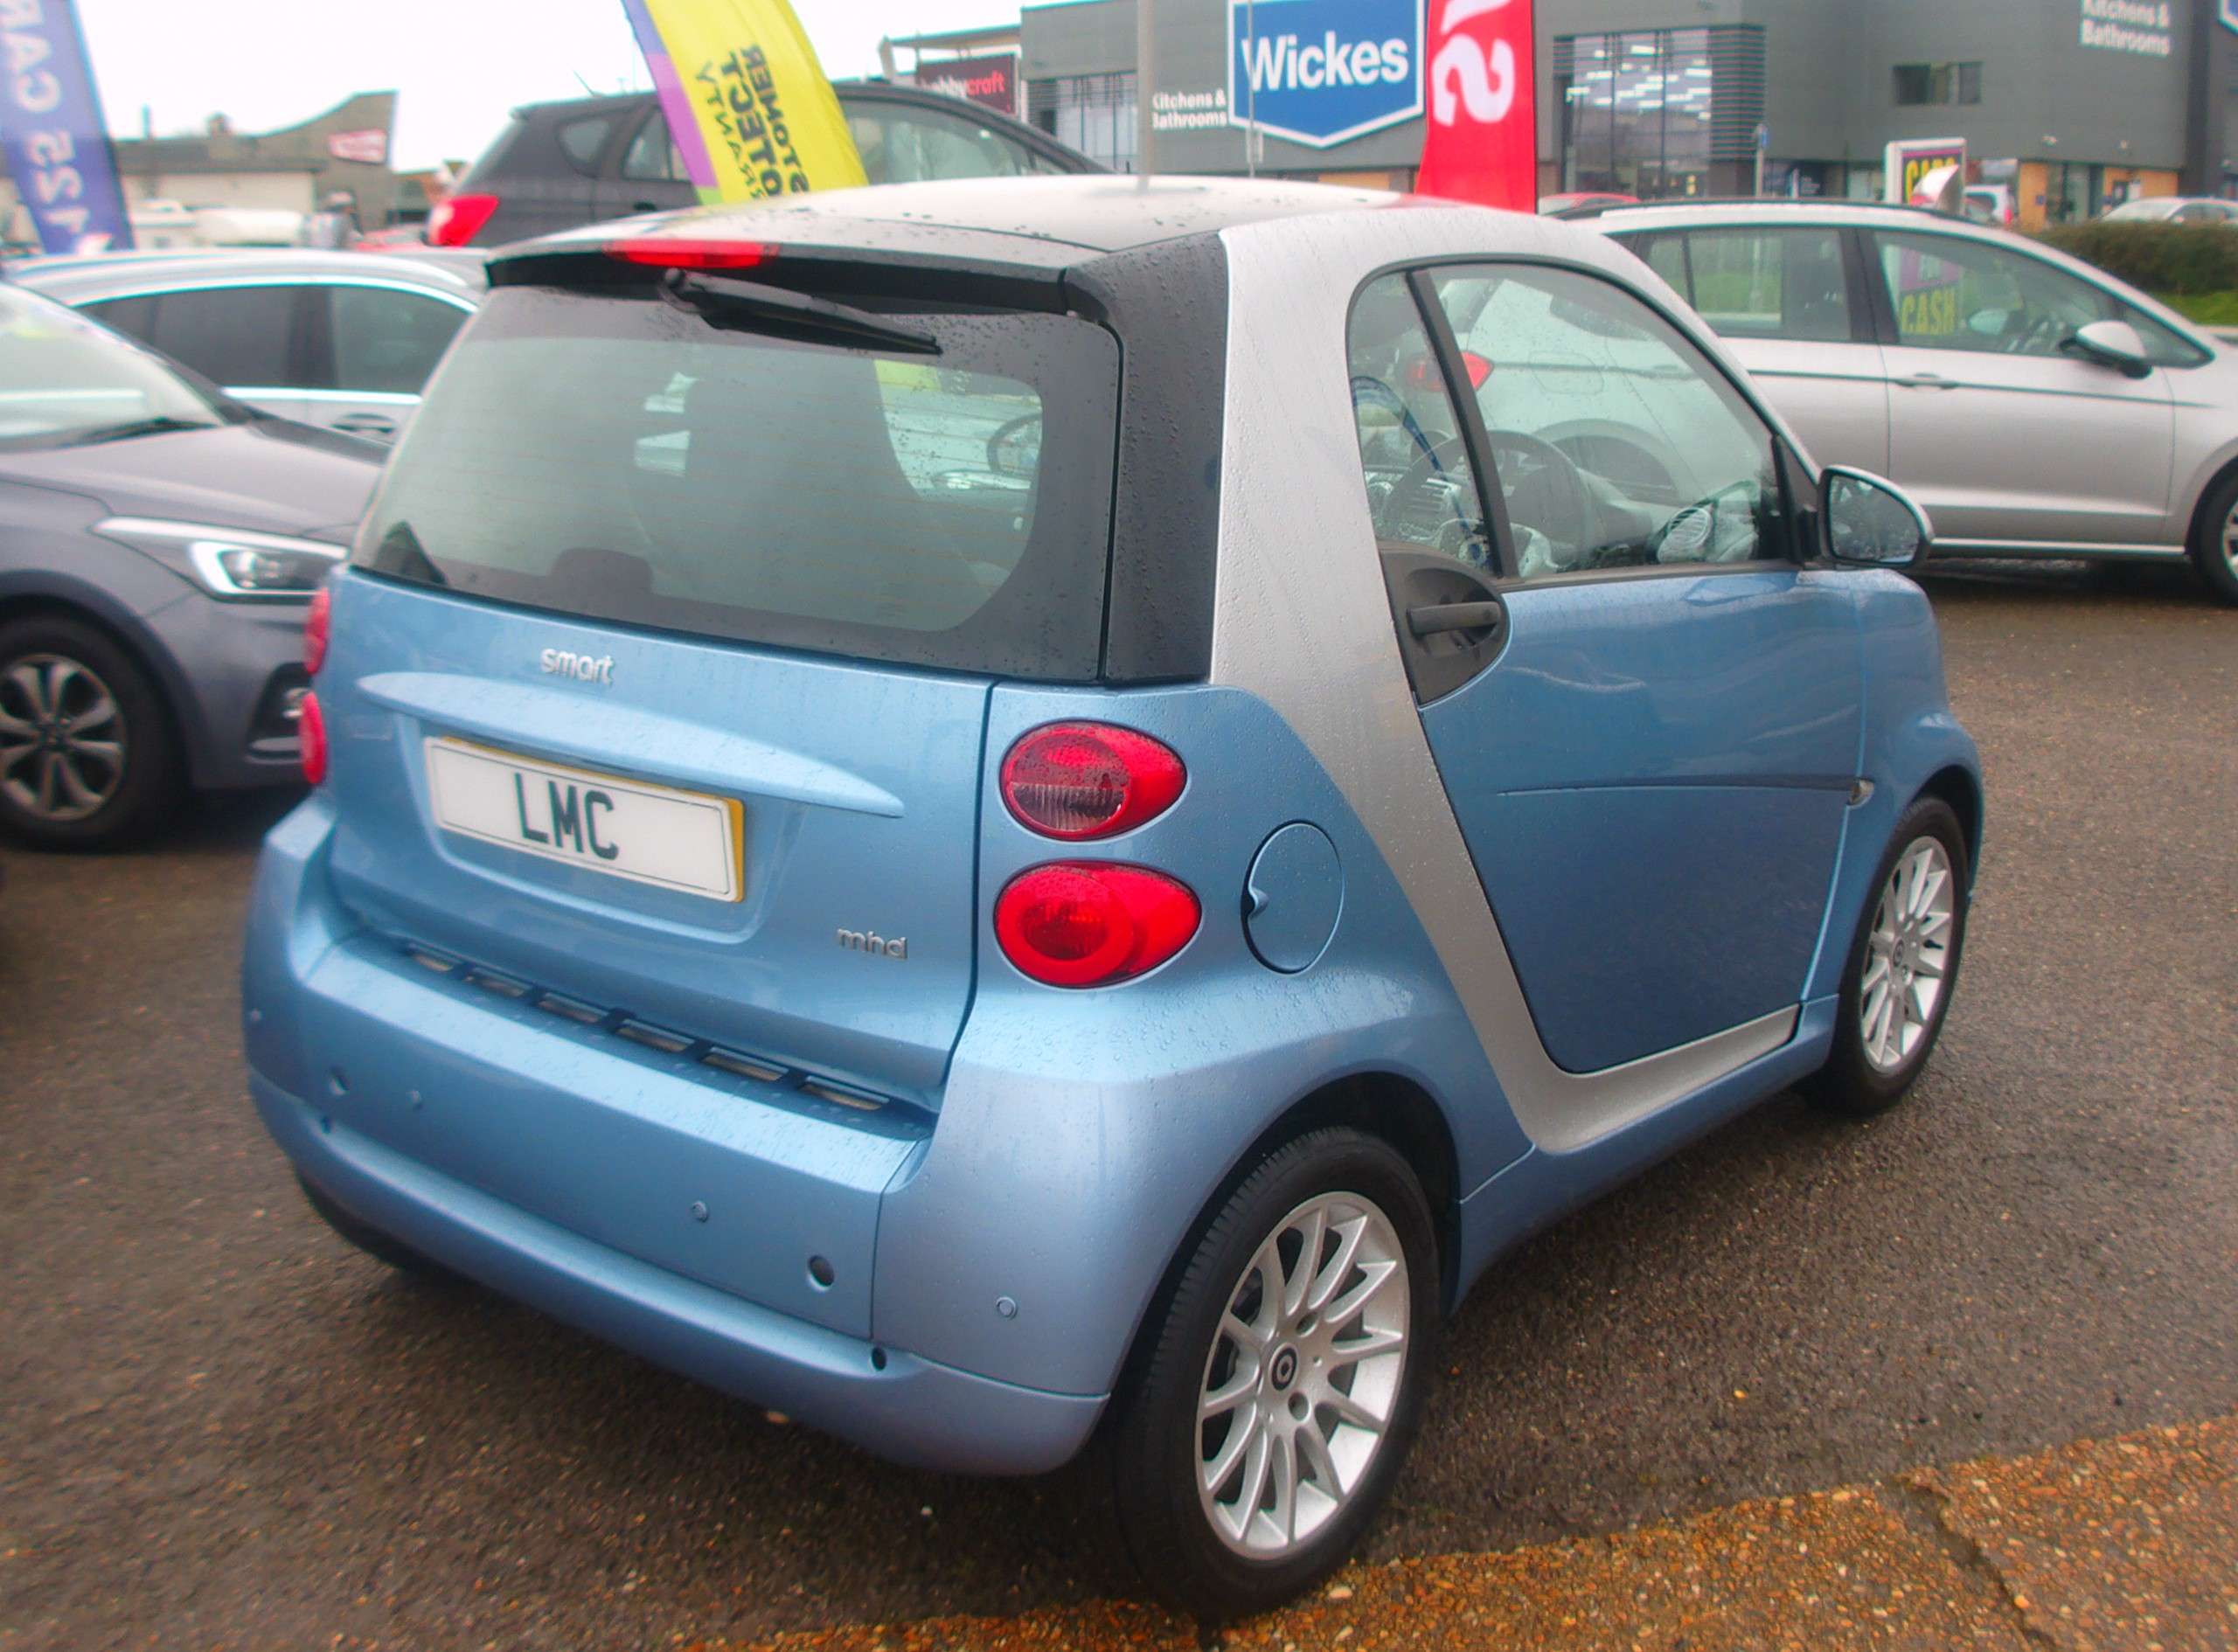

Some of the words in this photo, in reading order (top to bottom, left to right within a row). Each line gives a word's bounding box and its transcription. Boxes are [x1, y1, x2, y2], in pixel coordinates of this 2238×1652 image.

[1241, 31, 1409, 91] Wickes
[1901, 287, 1957, 336] CASH
[541, 649, 614, 685] smart
[514, 771, 620, 861] LMC
[837, 927, 907, 959] mhd
